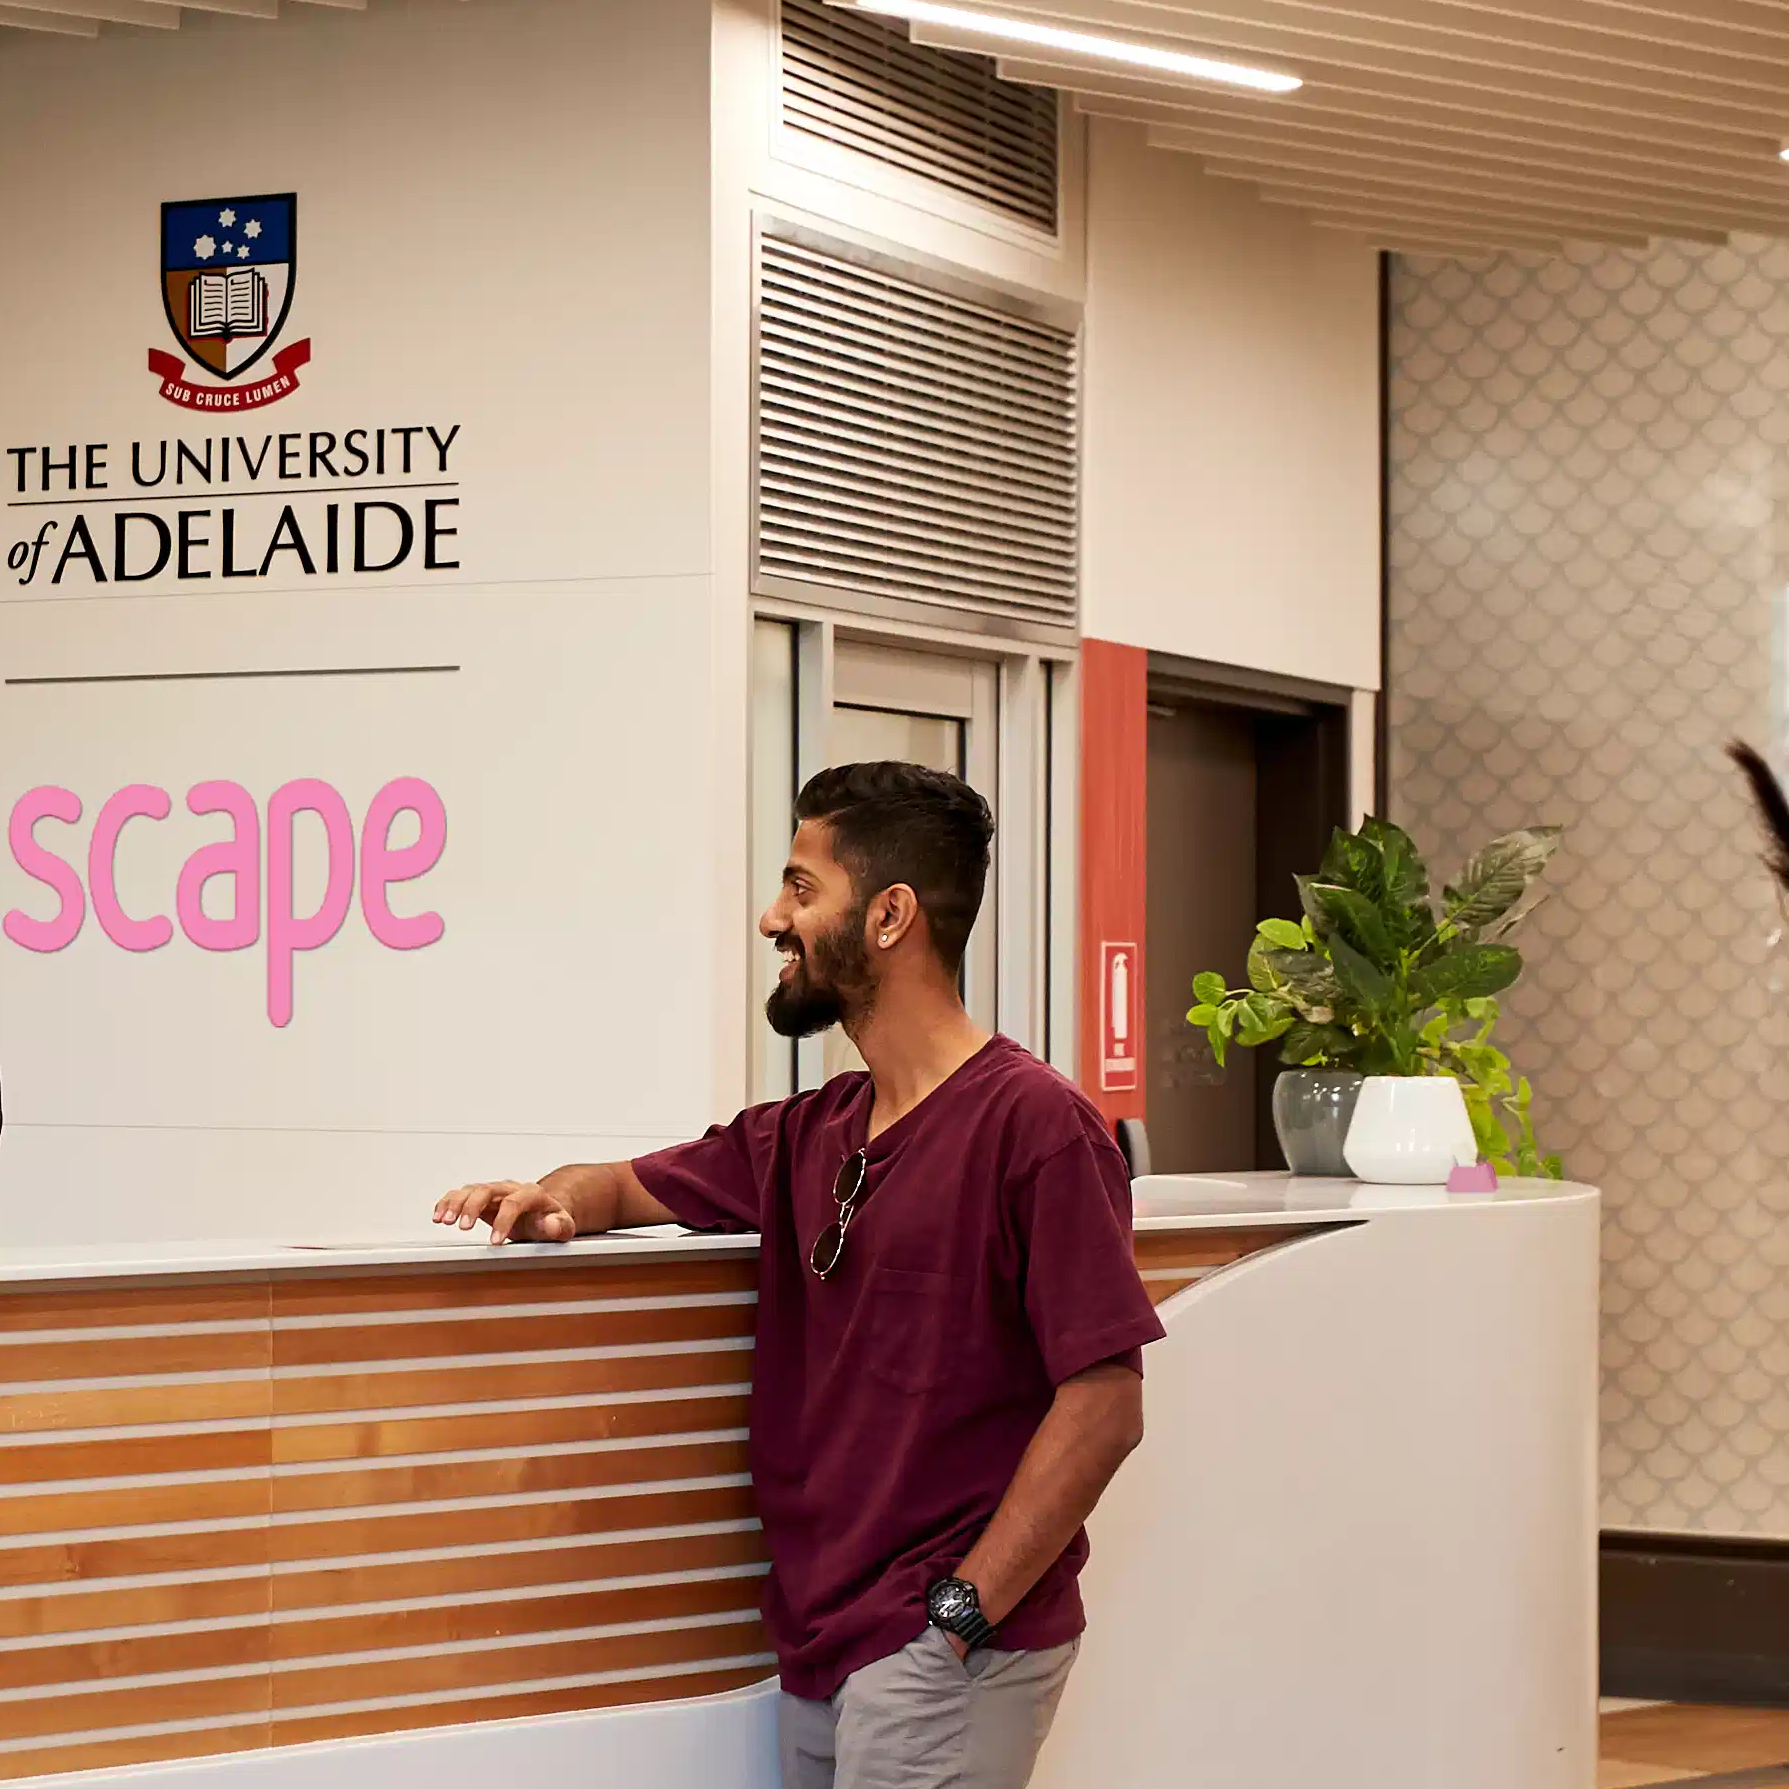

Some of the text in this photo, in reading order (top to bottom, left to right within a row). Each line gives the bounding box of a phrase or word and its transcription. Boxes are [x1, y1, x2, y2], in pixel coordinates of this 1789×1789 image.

[165, 375, 291, 407] SUB CRUCE LUMEN
[7, 425, 461, 492] THE UNIVERSITY
[7, 498, 461, 585] of ADELAIDE
[2, 776, 448, 1028] scape
